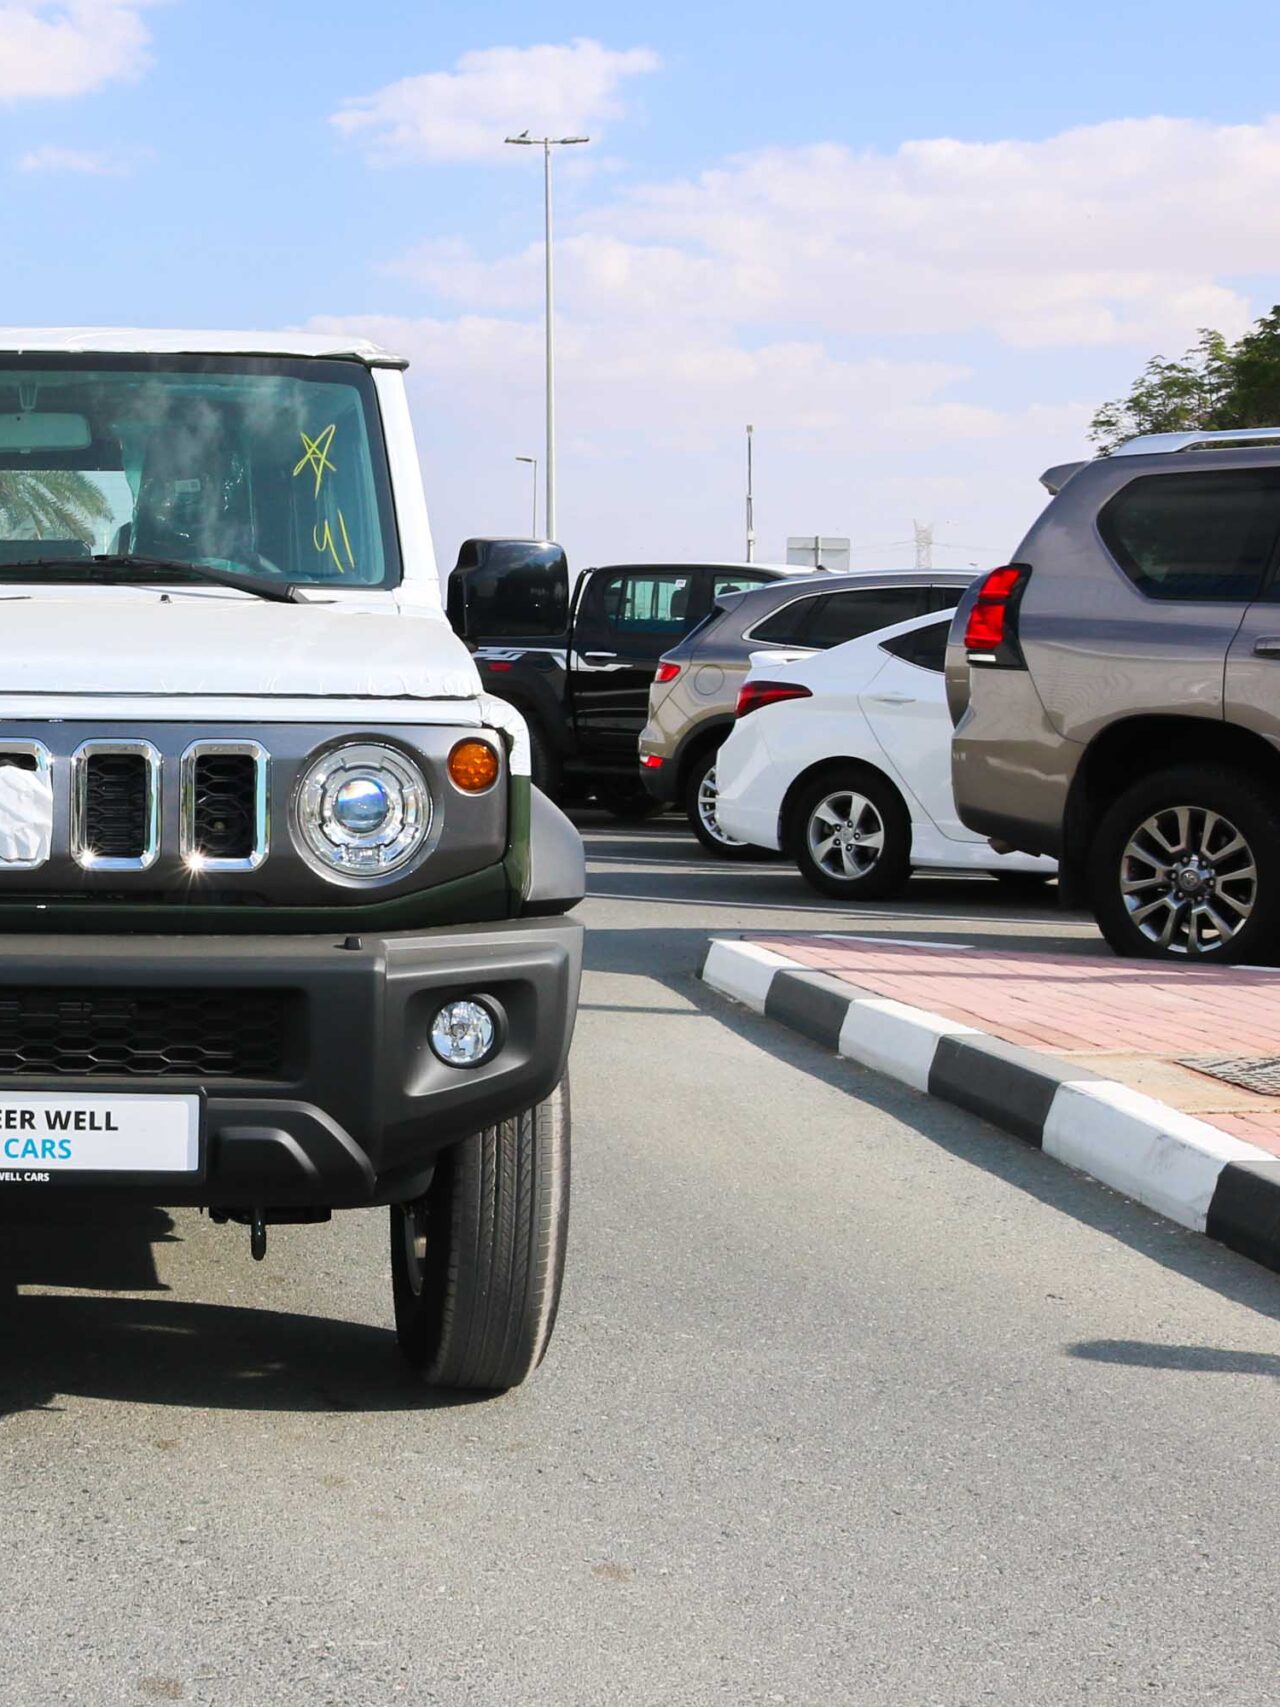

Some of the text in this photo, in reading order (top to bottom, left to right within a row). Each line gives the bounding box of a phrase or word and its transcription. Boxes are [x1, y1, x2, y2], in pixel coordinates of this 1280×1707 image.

[44, 1110, 119, 1131] WELL
[3, 1137, 73, 1160] CARS
[23, 1172, 50, 1182] CARS
